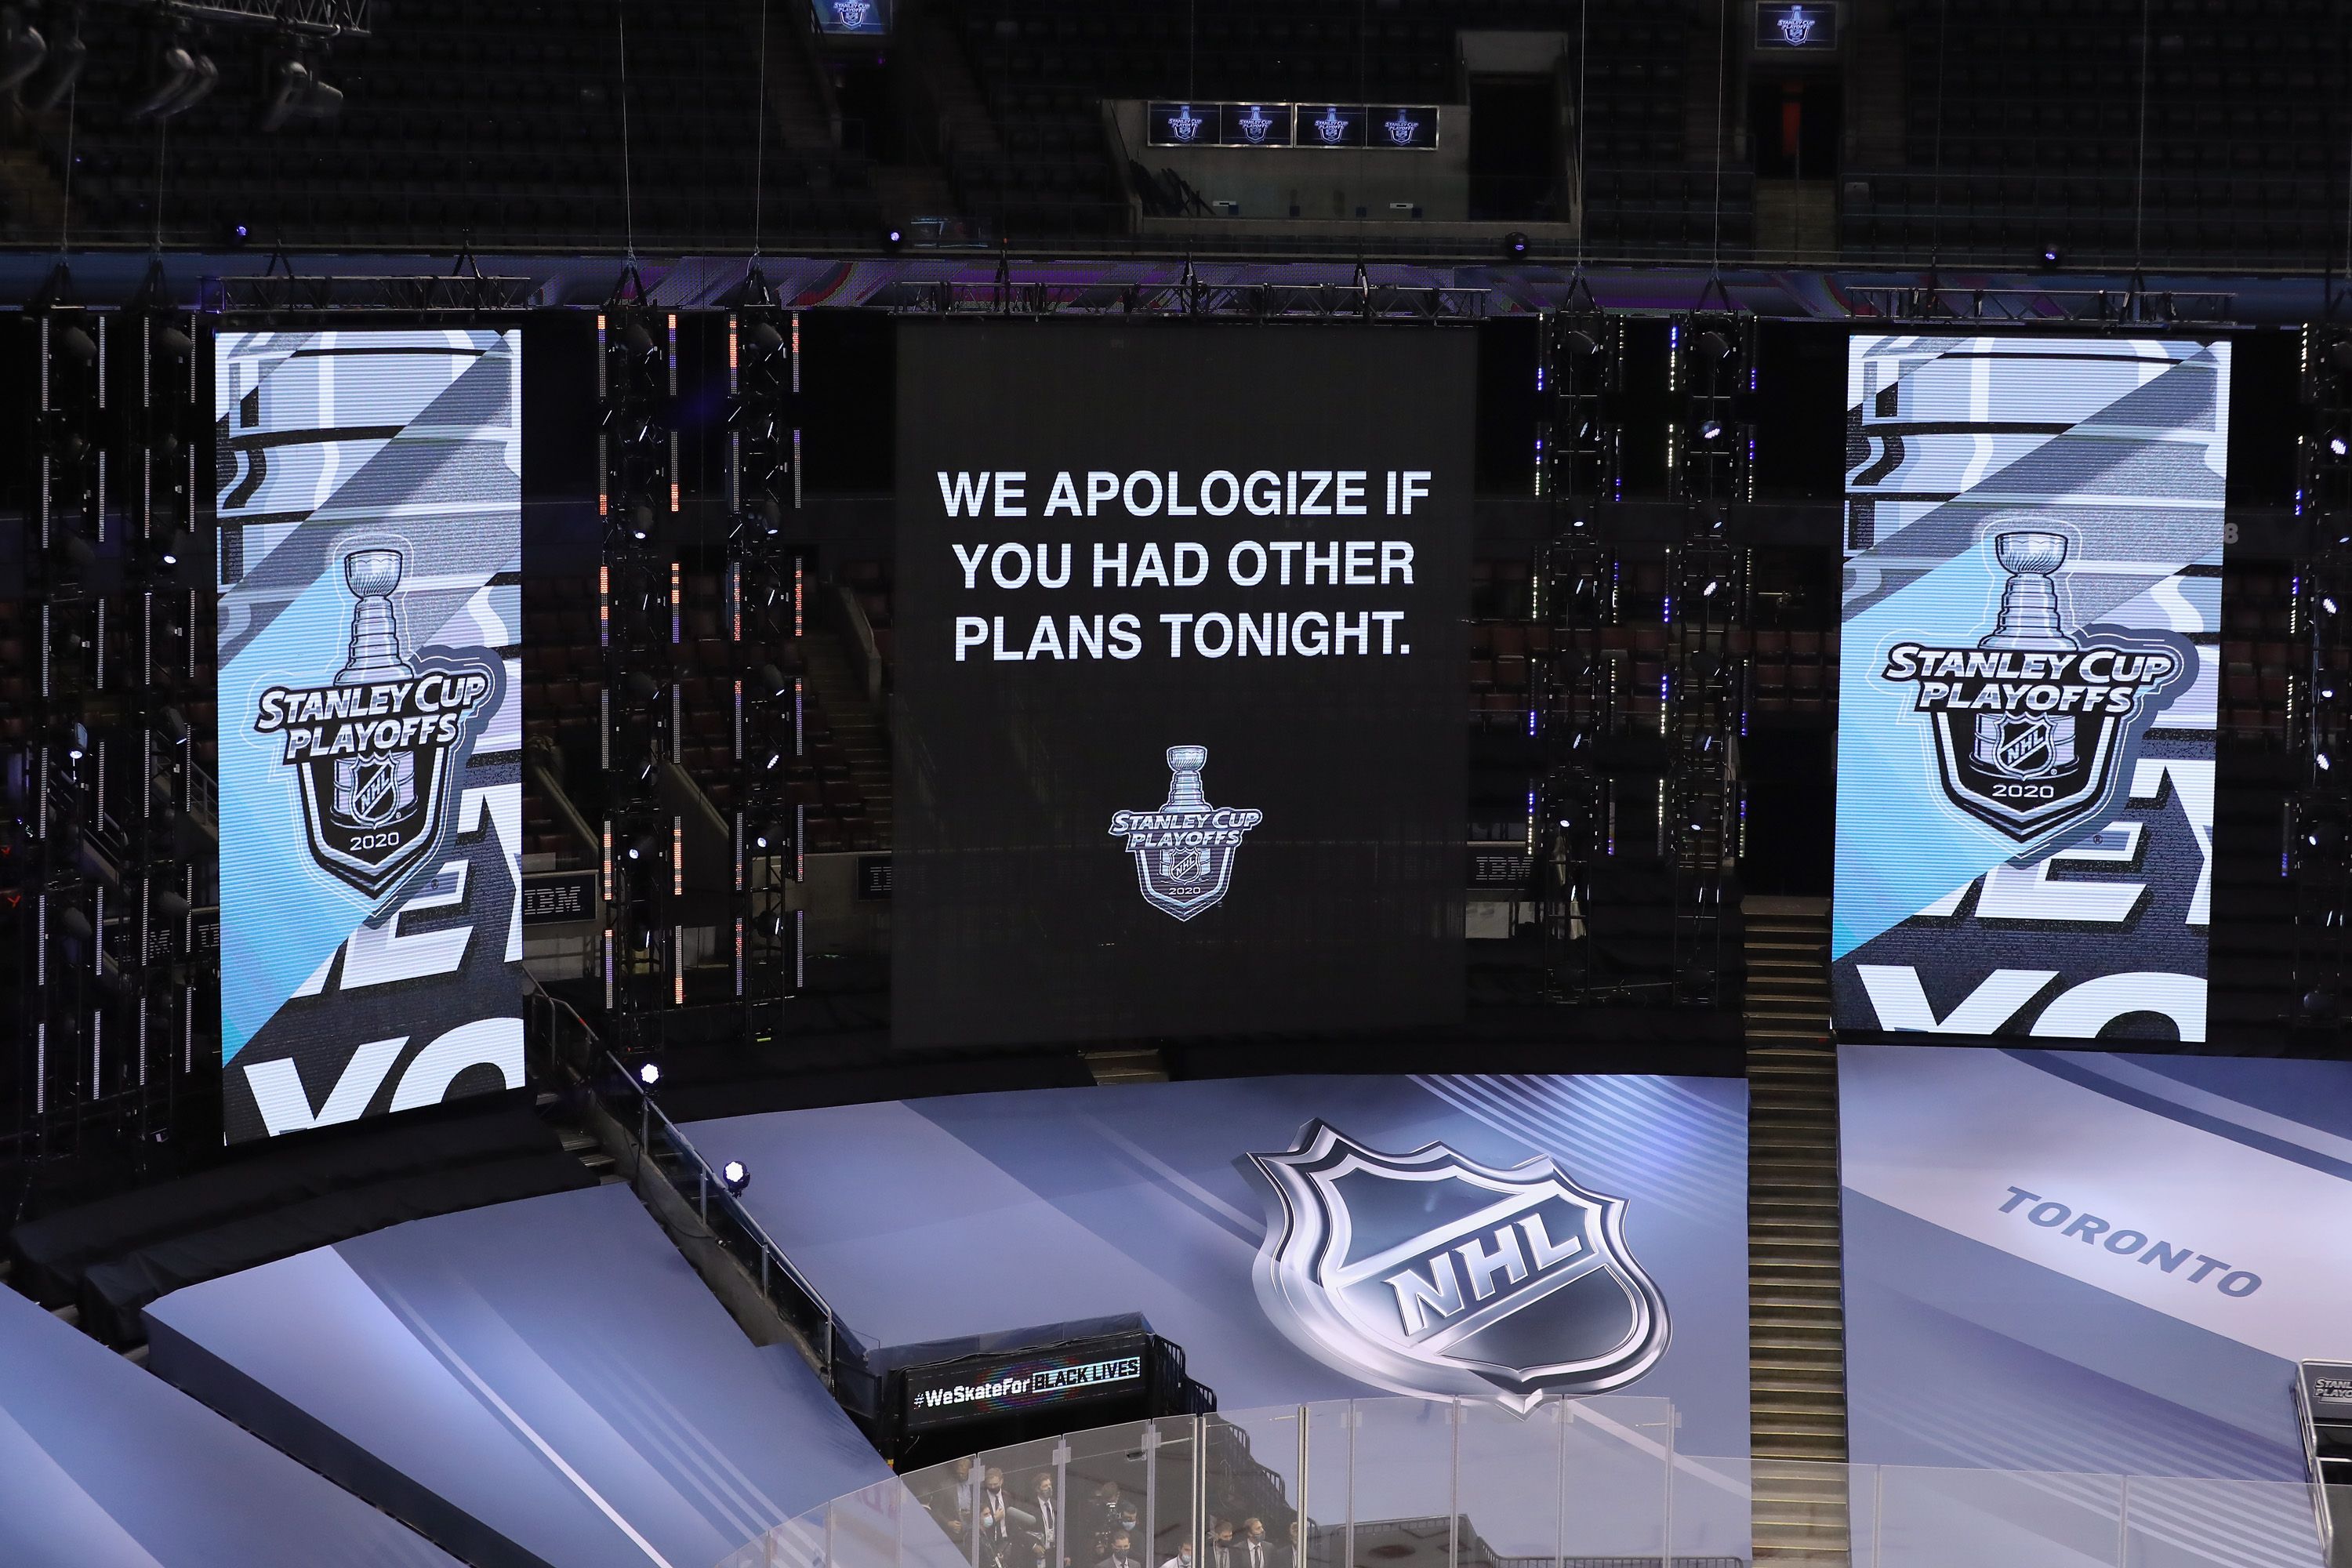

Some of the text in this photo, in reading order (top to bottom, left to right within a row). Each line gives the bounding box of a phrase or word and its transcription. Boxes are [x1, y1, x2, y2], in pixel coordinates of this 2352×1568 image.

[938, 470, 1431, 517] WE APOLOGIZE IF
[952, 541, 1414, 589] YOU HAD OTHER
[956, 612, 1409, 661] PLANS TONIGHT.
[1886, 647, 2172, 683] STANLEY CUP
[258, 676, 485, 728] STANLEY CUP
[1919, 681, 2133, 712] PLAYOFFS
[287, 713, 458, 759] PLAYOFFS
[2006, 728, 2045, 764] NHL
[361, 772, 390, 812] NHL
[1992, 783, 2055, 799] 2020
[1113, 811, 1260, 832] STANLEY CUP
[1131, 829, 1240, 848] PLAYOFFS
[350, 832, 400, 851] 2020
[1176, 855, 1196, 877] NHL
[1475, 856, 1534, 880] IBM
[524, 886, 581, 915] IBM
[1168, 887, 1201, 895] 2020
[1998, 1185, 2263, 1298] TORONTO
[1382, 1212, 1582, 1337] NHL
[913, 1359, 1138, 1410] #WeSkateFor BLACK LIVES
